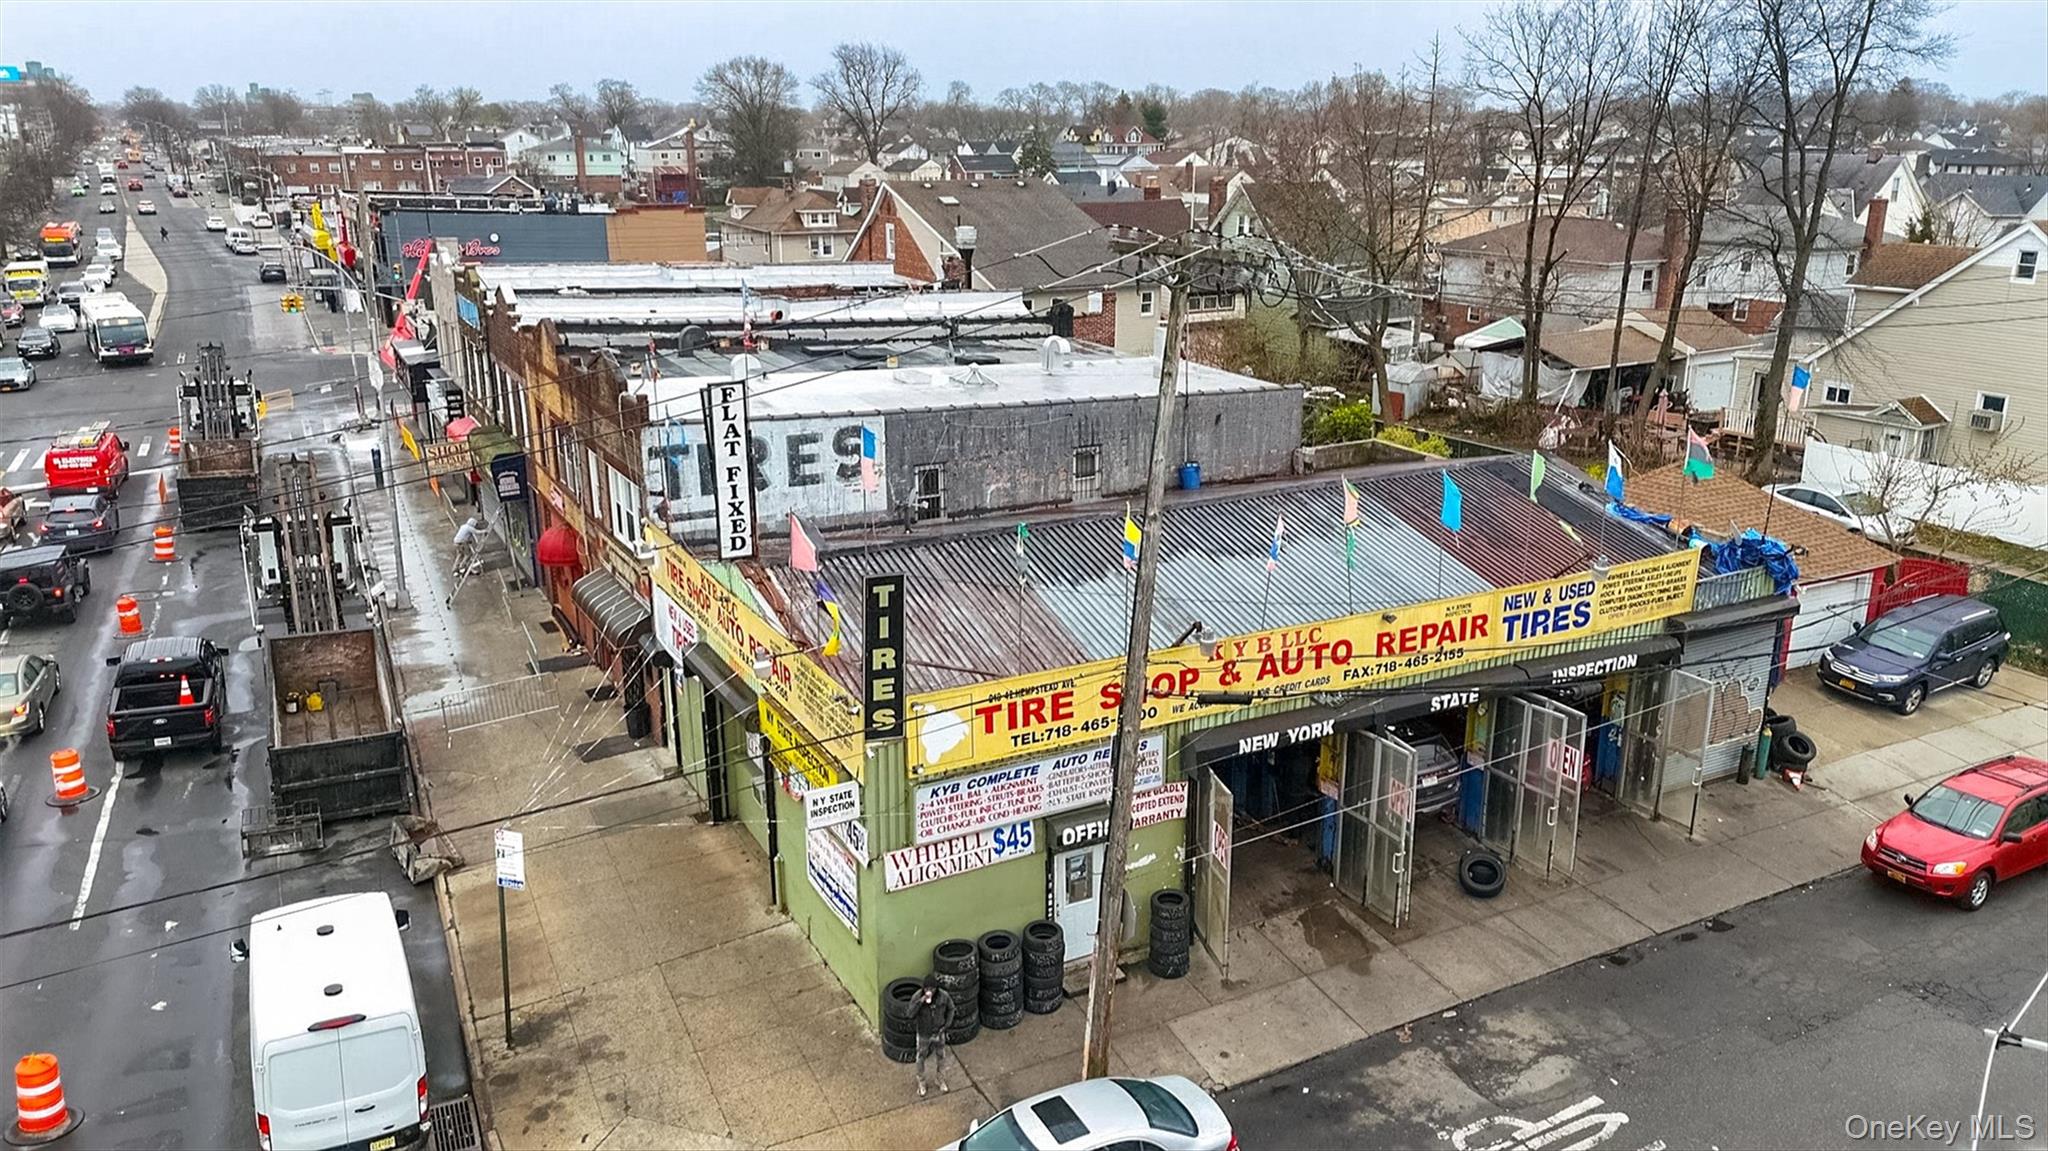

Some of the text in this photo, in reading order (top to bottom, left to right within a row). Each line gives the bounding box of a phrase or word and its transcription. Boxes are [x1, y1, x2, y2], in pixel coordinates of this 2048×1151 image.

[720, 387, 742, 457] FLAT
[726, 466, 748, 552] FIXED
[1503, 581, 1595, 612] NEW & USED
[1281, 627, 1322, 649] LLC
[1503, 601, 1592, 642] TIRES
[872, 584, 897, 731] TIRES
[975, 689, 1074, 734] TIRE
[1219, 660, 1242, 686] &
[1256, 639, 1353, 681] AUTO
[1376, 613, 1489, 658] REPAIR
[1172, 704, 1185, 714] WE
[1304, 675, 1331, 688] CARDS
[1238, 655, 1638, 754] NEW YORK STATE INSPECTION
[930, 753, 1087, 799] KYB COMPLETE AUTO
[991, 776, 1038, 794] ALIGNMENT
[810, 800, 855, 818] INSPECTION
[829, 790, 853, 803] STATE
[1158, 794, 1185, 808] EXTEND
[1134, 808, 1183, 827] ARRANTY
[993, 820, 1032, 858] $45
[894, 847, 995, 888] ALIGNMENT
